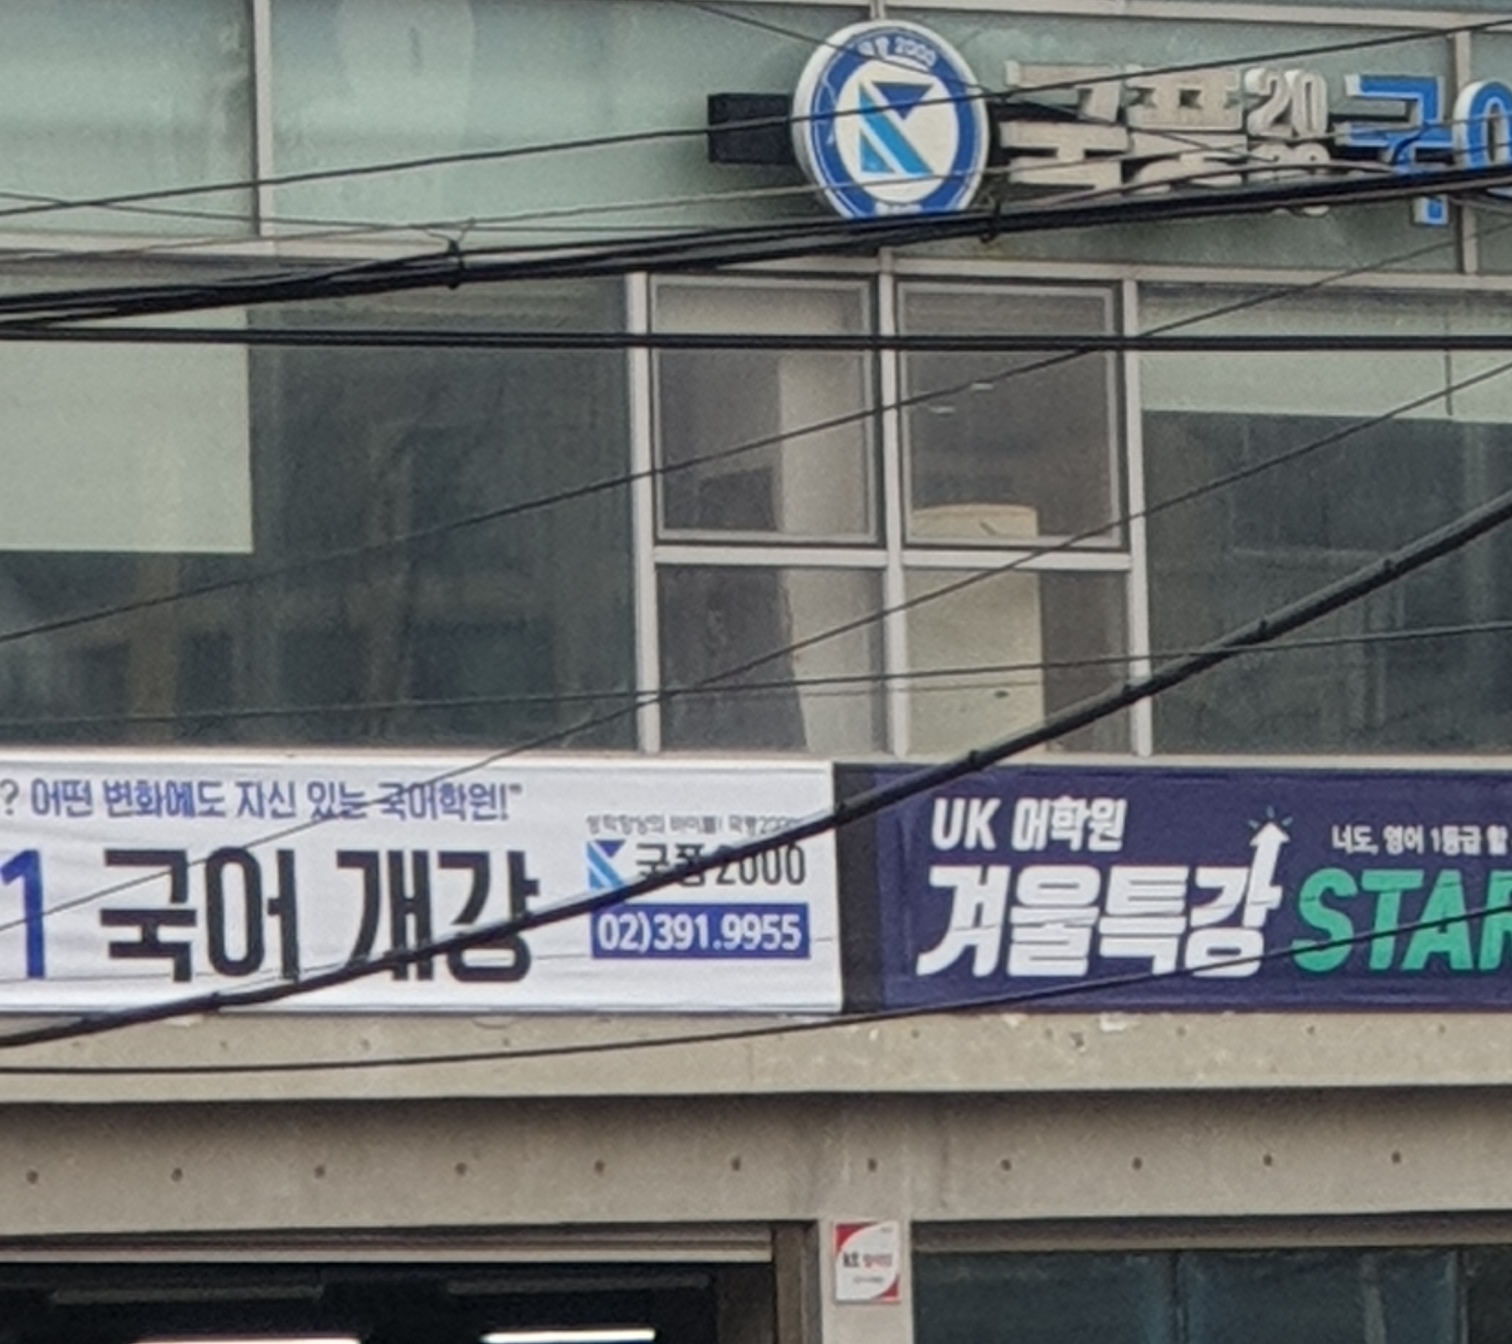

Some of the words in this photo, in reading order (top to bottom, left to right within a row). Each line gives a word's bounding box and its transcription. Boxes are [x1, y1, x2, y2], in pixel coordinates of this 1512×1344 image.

[31, 779, 93, 815] 어떤
[103, 779, 225, 820] 변화에도
[235, 780, 297, 819] 자신
[306, 783, 368, 820] 있는
[931, 798, 1001, 850] UK
[1010, 796, 1128, 851] 어학원
[100, 848, 302, 982] 국어
[336, 849, 539, 983] 개강
[915, 822, 1283, 977] 겨울특강
[598, 912, 803, 954] 02)391.9955
